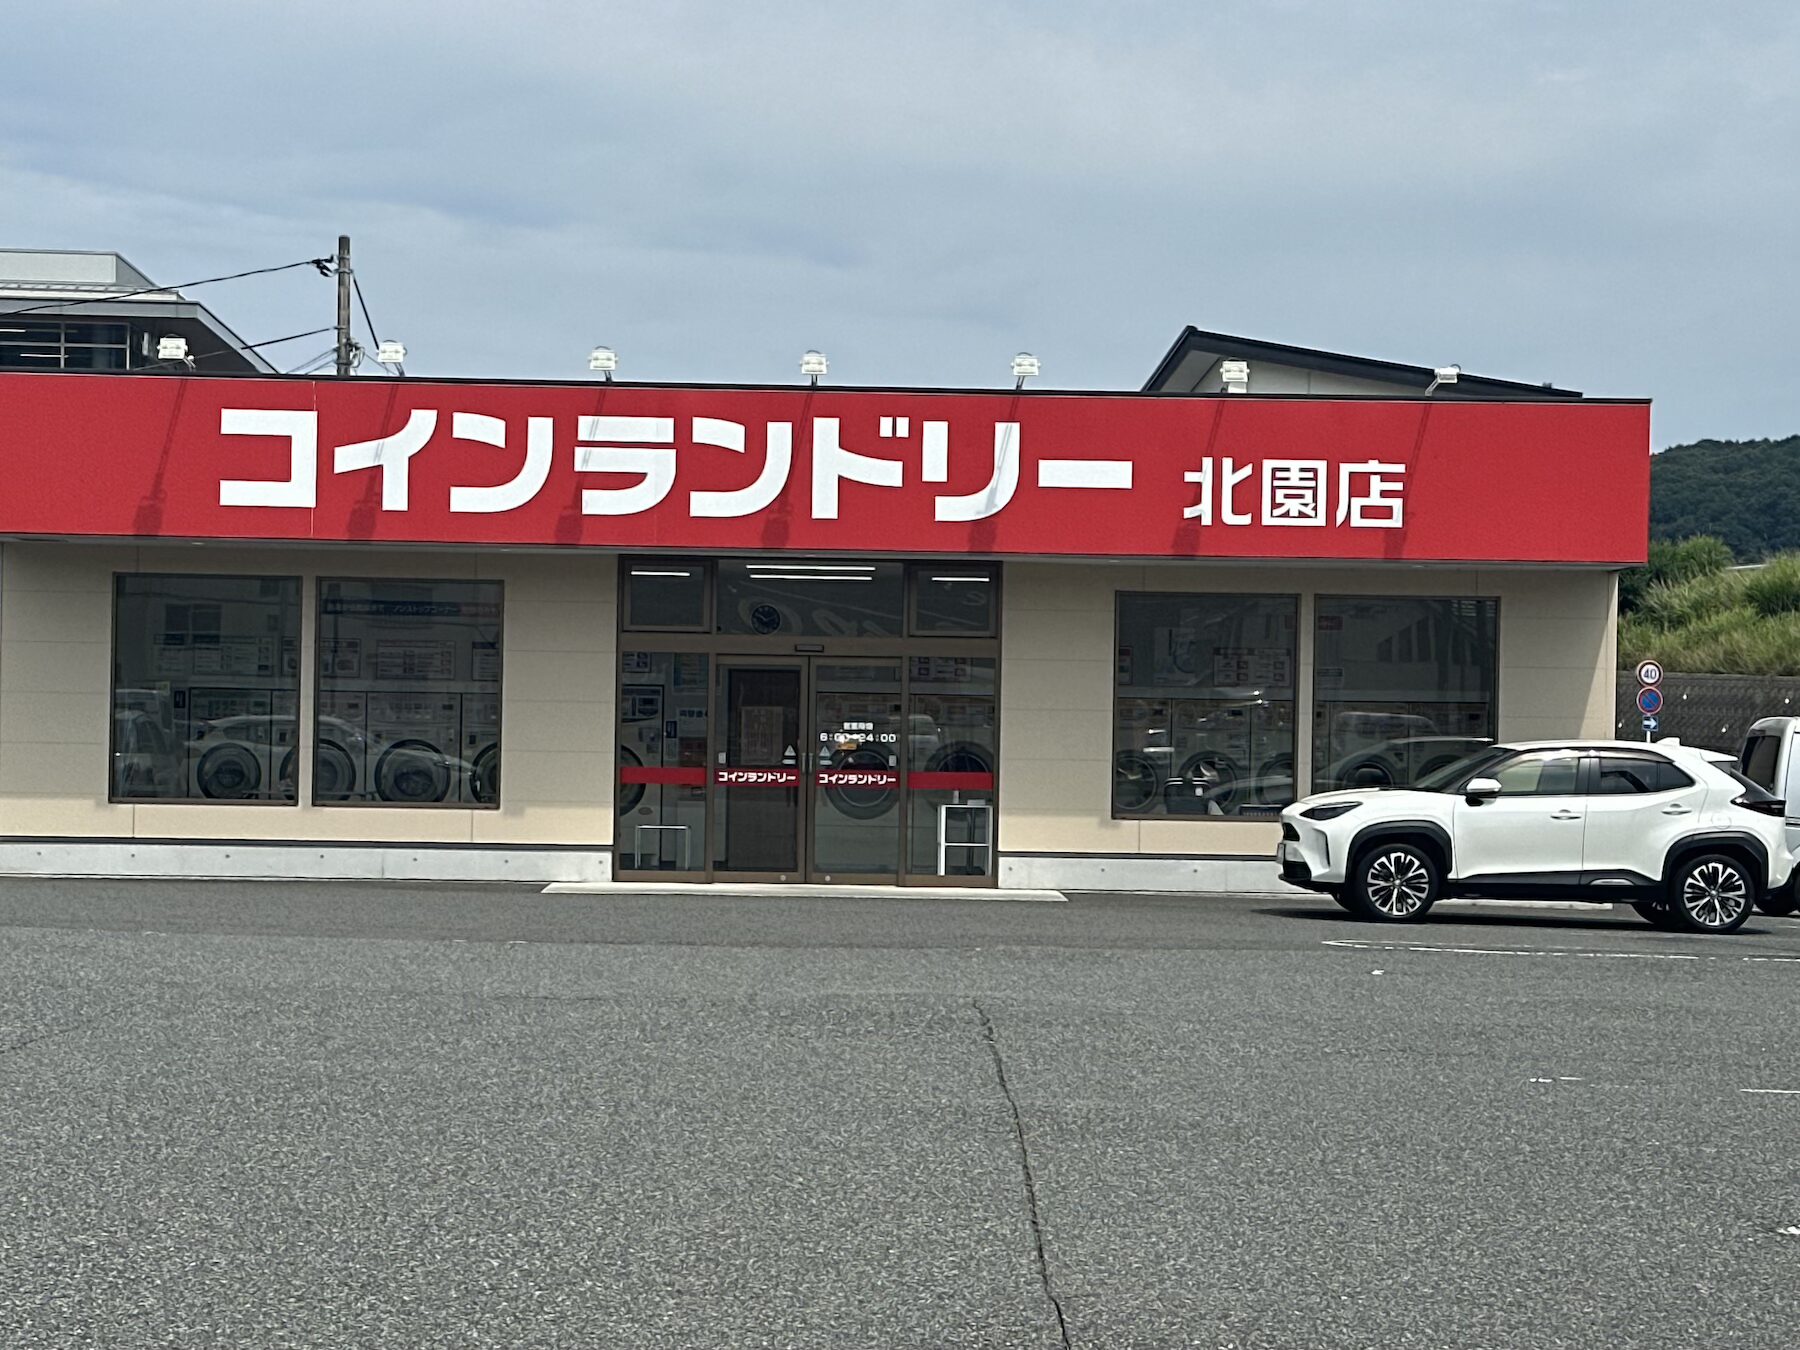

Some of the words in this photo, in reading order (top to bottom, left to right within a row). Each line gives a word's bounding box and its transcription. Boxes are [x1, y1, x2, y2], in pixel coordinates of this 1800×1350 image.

[219, 407, 1134, 522] コインランドリー
[1183, 456, 1406, 529] 北園店
[1643, 668, 1657, 680] 40
[718, 771, 797, 783] コインランドリー
[818, 773, 897, 785] コインランドリー
